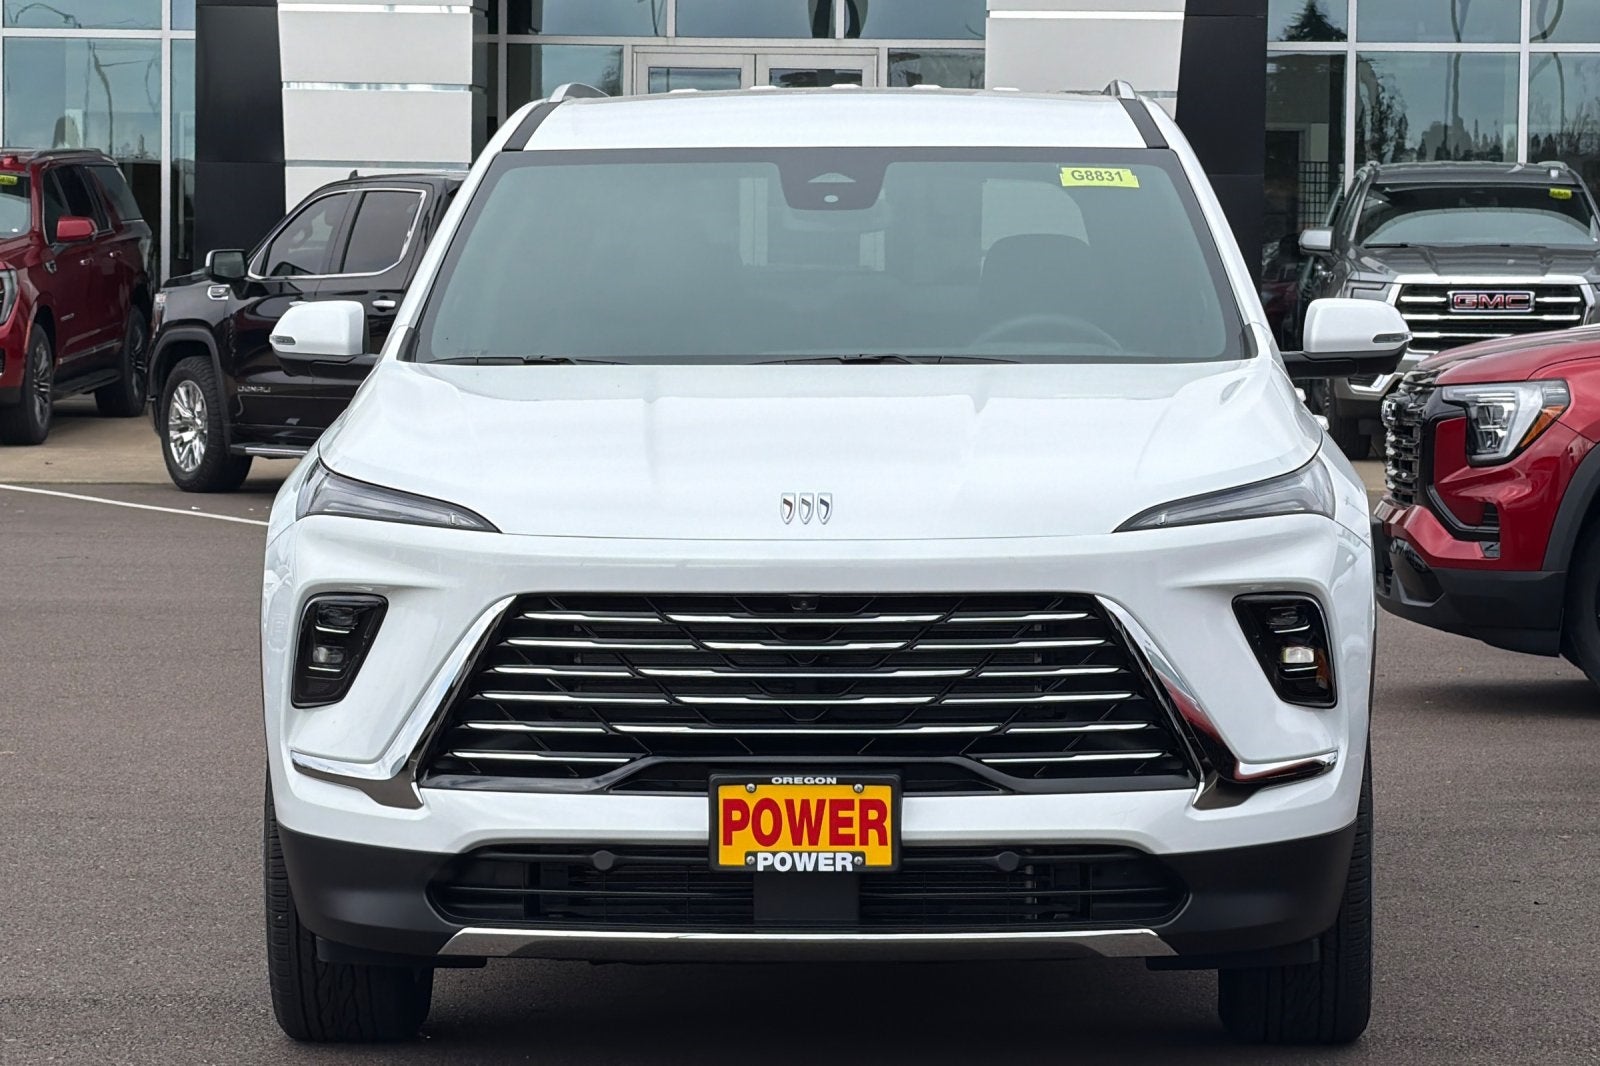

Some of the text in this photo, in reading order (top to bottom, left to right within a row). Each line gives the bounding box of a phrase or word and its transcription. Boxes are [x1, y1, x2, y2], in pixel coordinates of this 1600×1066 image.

[1071, 170, 1123, 182] G8831
[1453, 294, 1530, 309] GMC
[771, 777, 837, 785] OREGON
[722, 797, 889, 847] POWER
[756, 851, 854, 873] POWER
